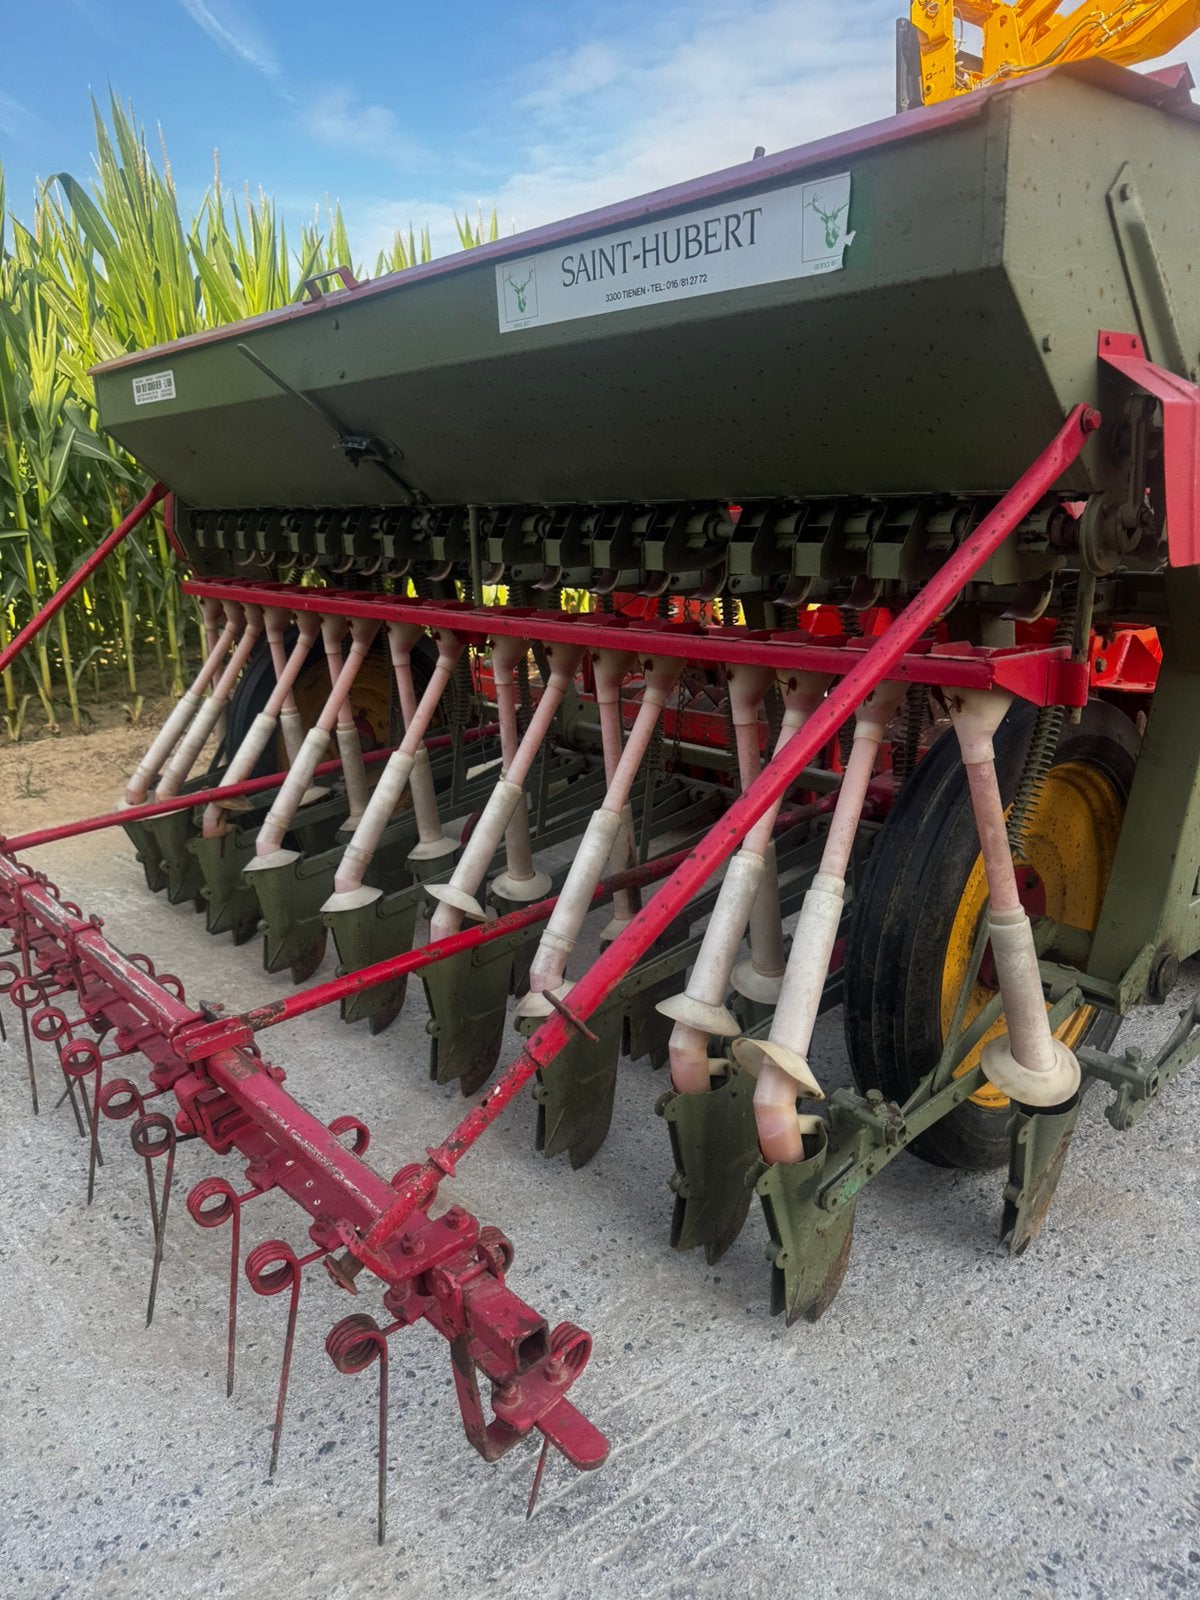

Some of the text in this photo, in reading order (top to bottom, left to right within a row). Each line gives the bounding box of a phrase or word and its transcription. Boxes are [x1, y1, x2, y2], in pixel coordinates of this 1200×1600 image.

[561, 207, 762, 287] SAINT-HUBERT
[605, 291, 621, 302] 3300
[622, 286, 646, 299] TIENEN
